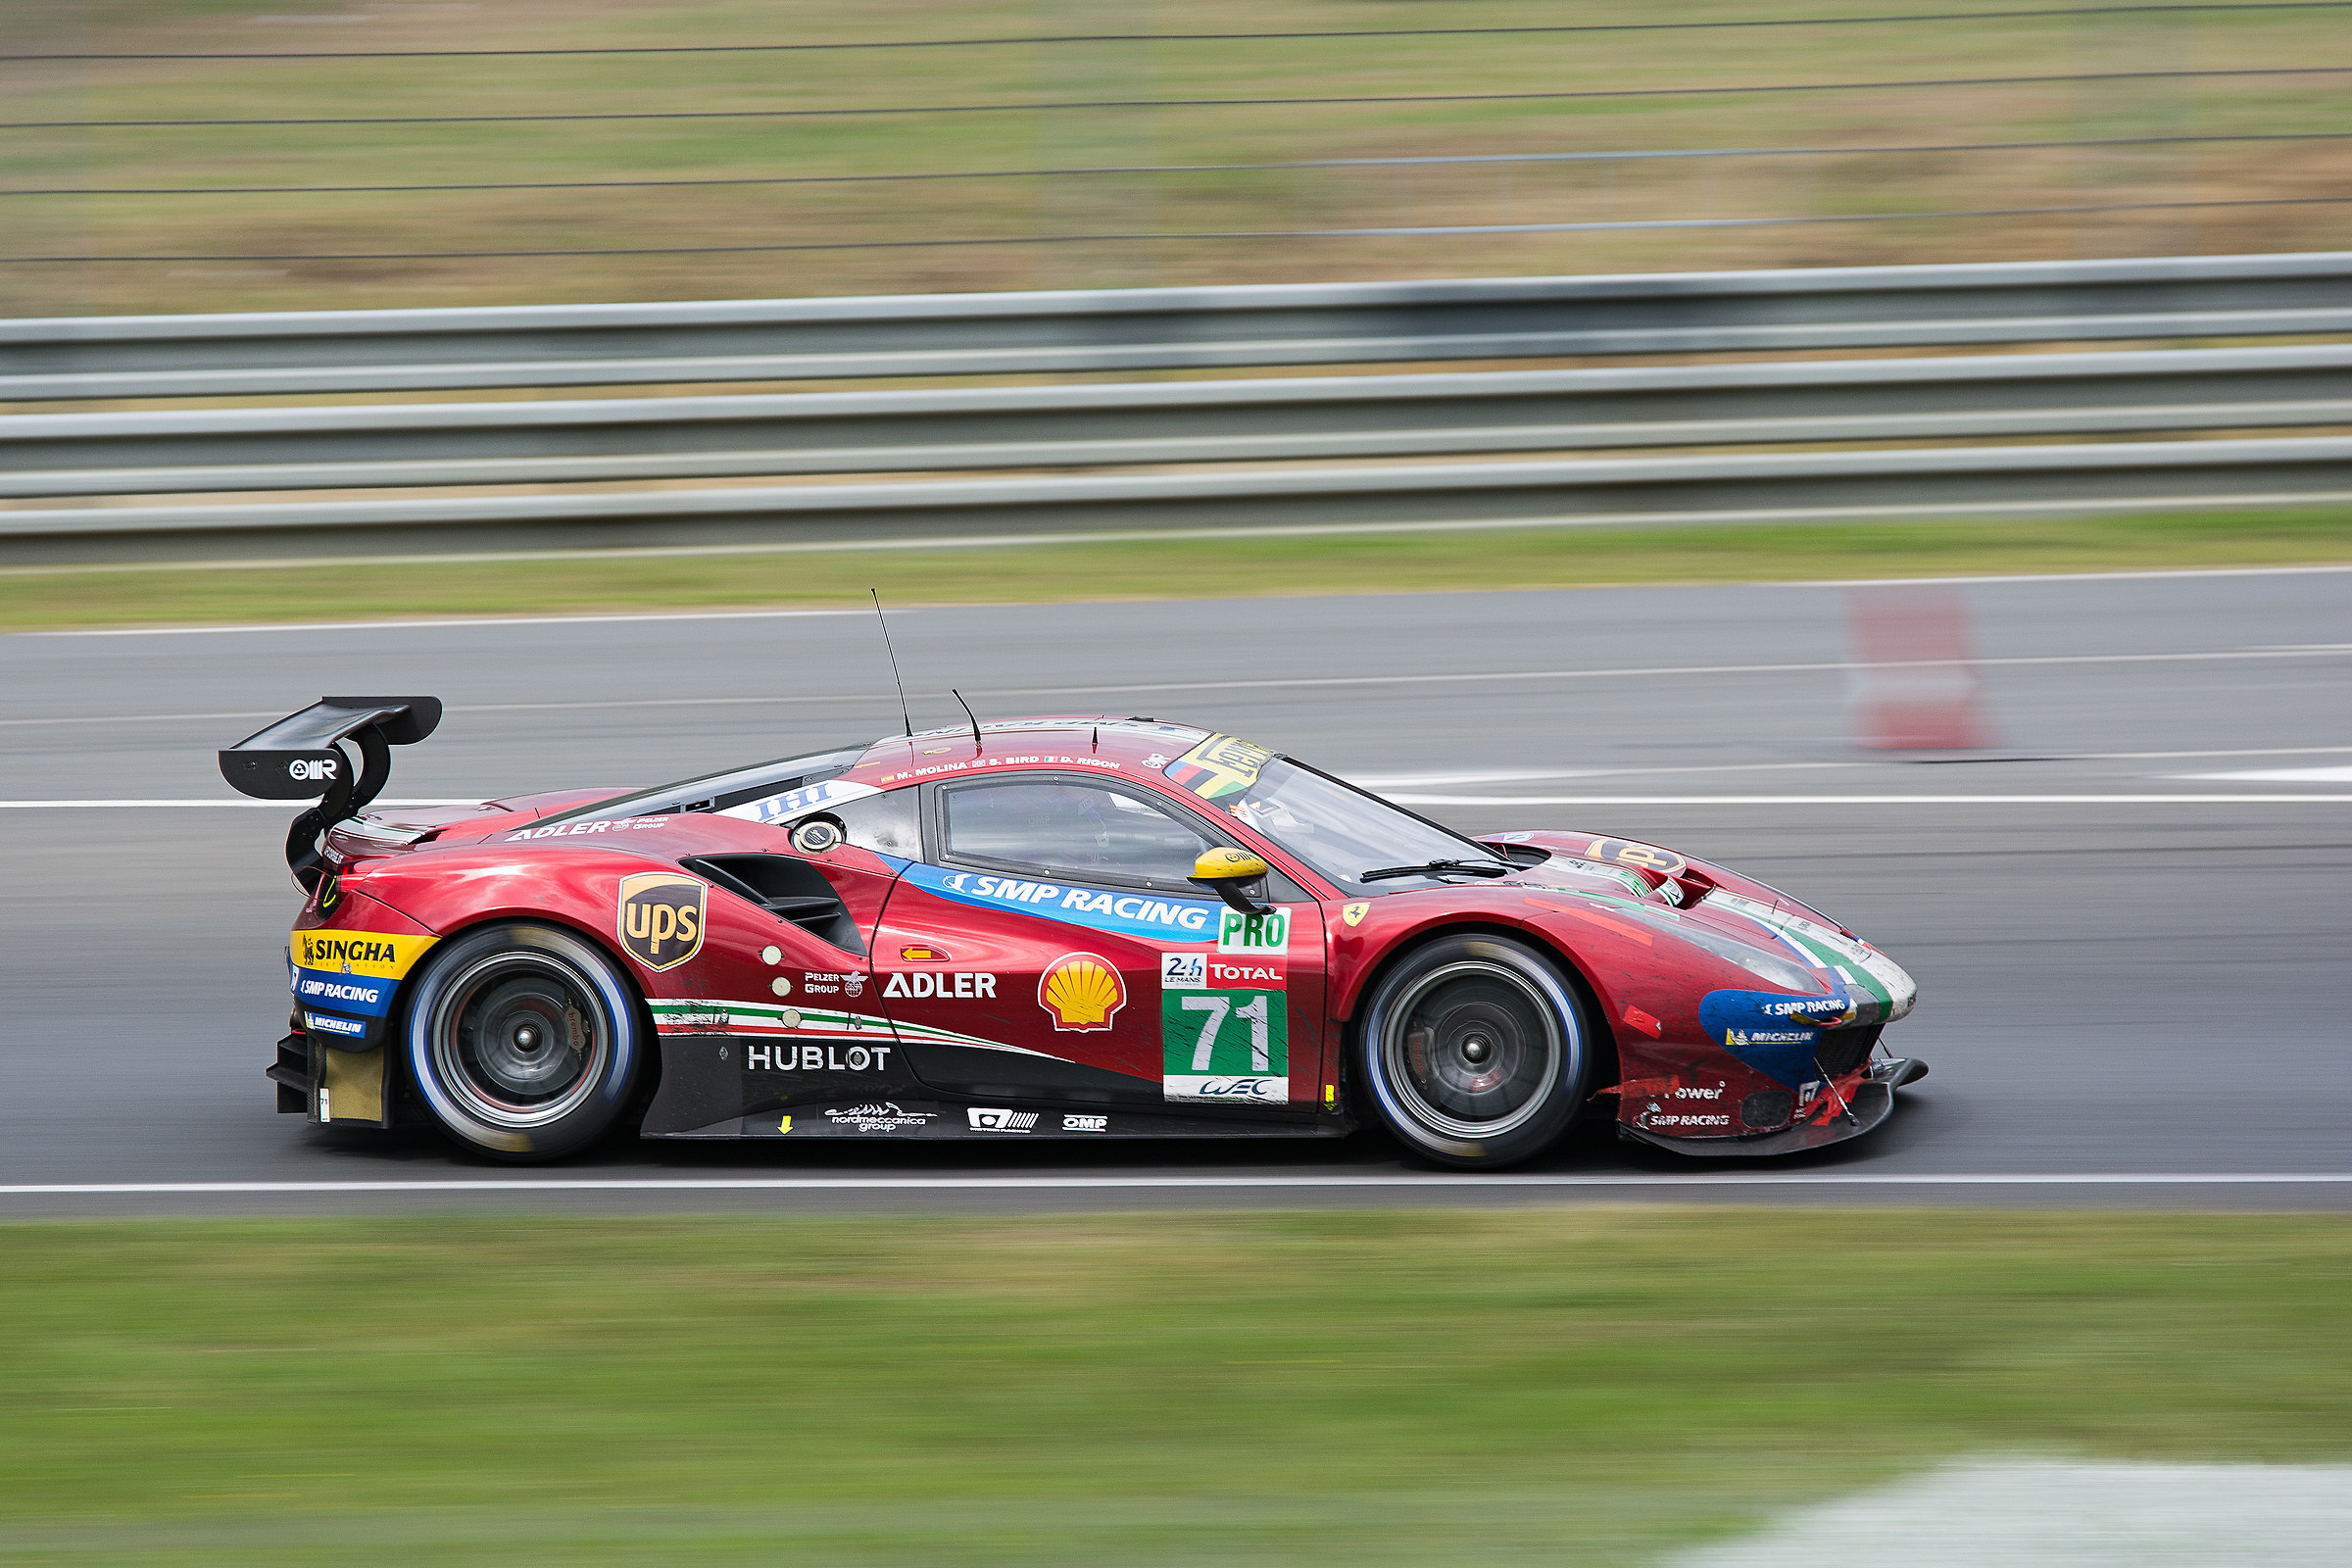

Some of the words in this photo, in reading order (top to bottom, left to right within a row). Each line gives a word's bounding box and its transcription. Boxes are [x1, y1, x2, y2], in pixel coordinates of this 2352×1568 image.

[915, 761, 968, 776] MOLINA
[1005, 756, 1040, 764] BIRD
[1077, 757, 1121, 769] RIGON
[755, 783, 831, 821] IHI
[503, 820, 612, 843] ADLER
[970, 876, 1059, 905] SMP
[1060, 888, 1210, 930] RACING
[626, 902, 698, 955] ups
[1222, 913, 1286, 948] PRO
[315, 939, 396, 963] SINGHA
[1166, 956, 1202, 977] 24h
[1208, 963, 1284, 981] TOTAL
[804, 971, 841, 983] PELZER
[881, 972, 998, 999] ADLER
[304, 980, 325, 997] SMP
[323, 983, 380, 1004] RACING
[804, 983, 840, 994] GROUP
[1775, 1002, 1806, 1015] SMP
[1805, 999, 1846, 1013] RACING
[314, 1016, 363, 1034] MICHELIN
[1181, 995, 1269, 1072] 71
[1750, 1031, 1814, 1042] MICHELIN
[748, 1045, 892, 1071] HUBLOT
[1199, 1078, 1273, 1096] WEC
[831, 1114, 926, 1125] nordmeccanica
[858, 1122, 897, 1133] group
[1062, 1116, 1108, 1129] OMP
[1680, 1115, 1730, 1126] RACING
